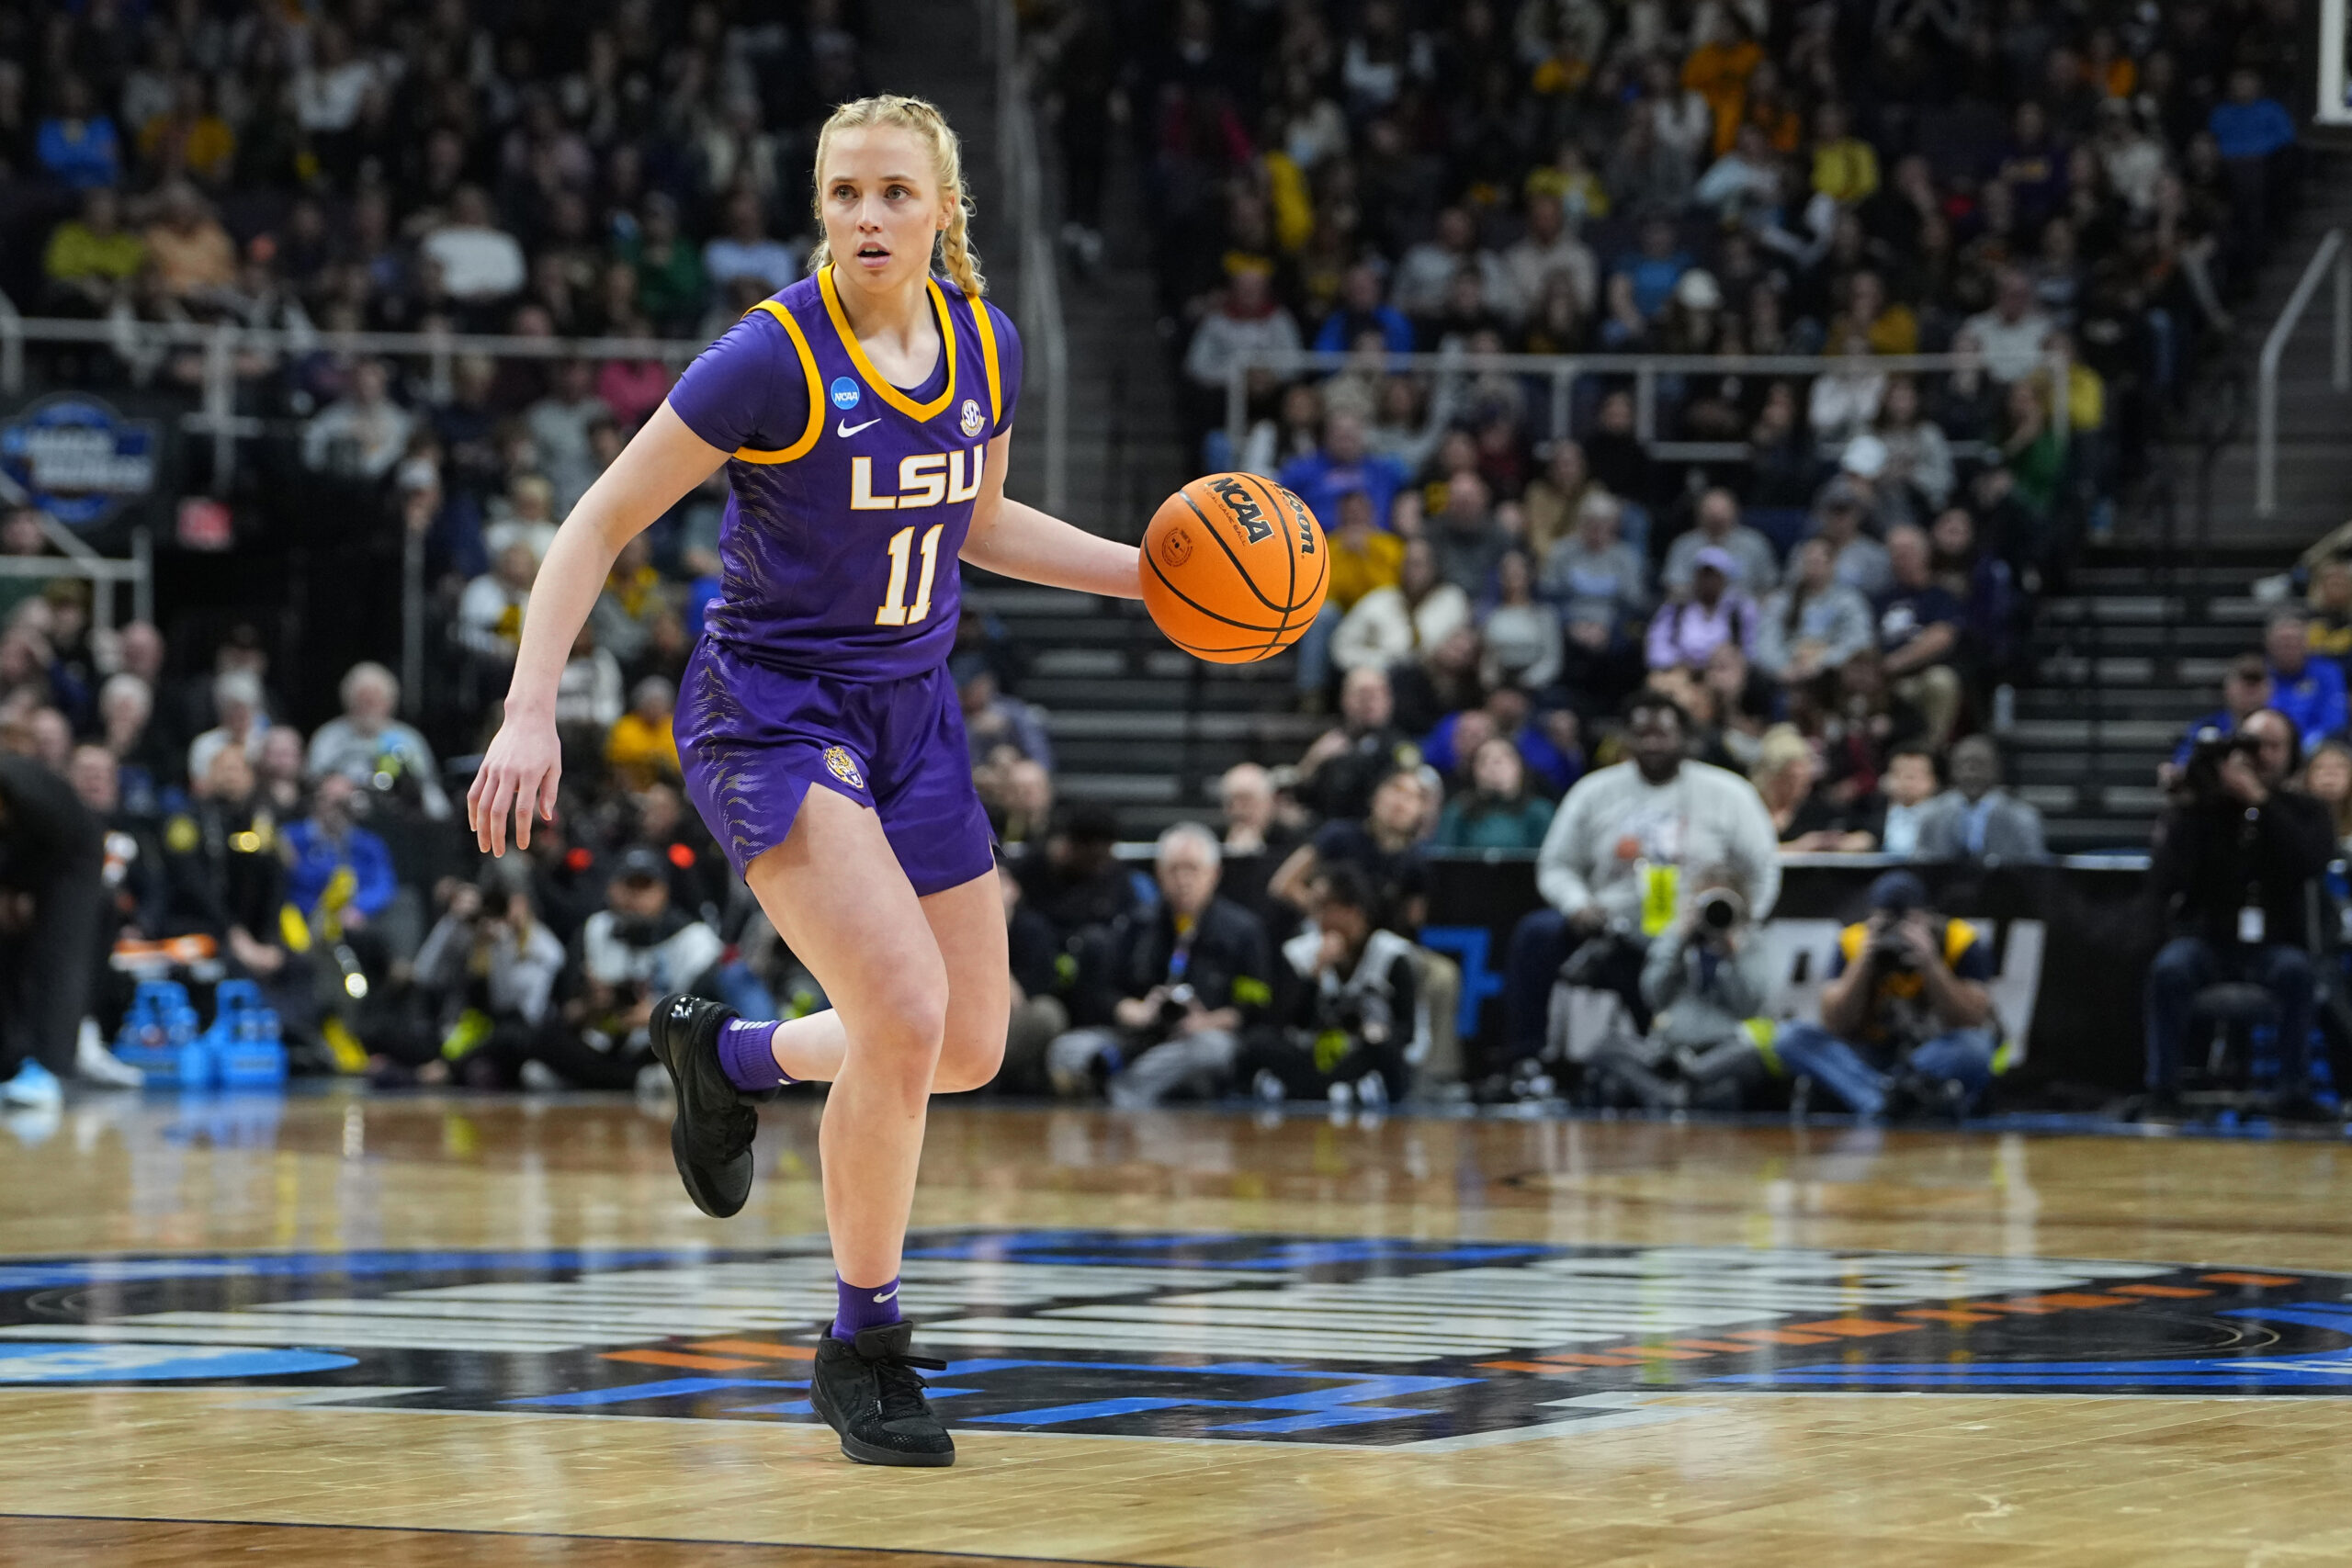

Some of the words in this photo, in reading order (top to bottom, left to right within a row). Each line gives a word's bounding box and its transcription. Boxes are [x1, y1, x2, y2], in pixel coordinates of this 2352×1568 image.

[834, 391, 859, 402] NCAA
[962, 401, 980, 428] SEC
[850, 444, 984, 511] LSU
[1204, 477, 1275, 546] NCAA
[1232, 524, 1247, 547] BALL
[874, 523, 945, 626] 11
